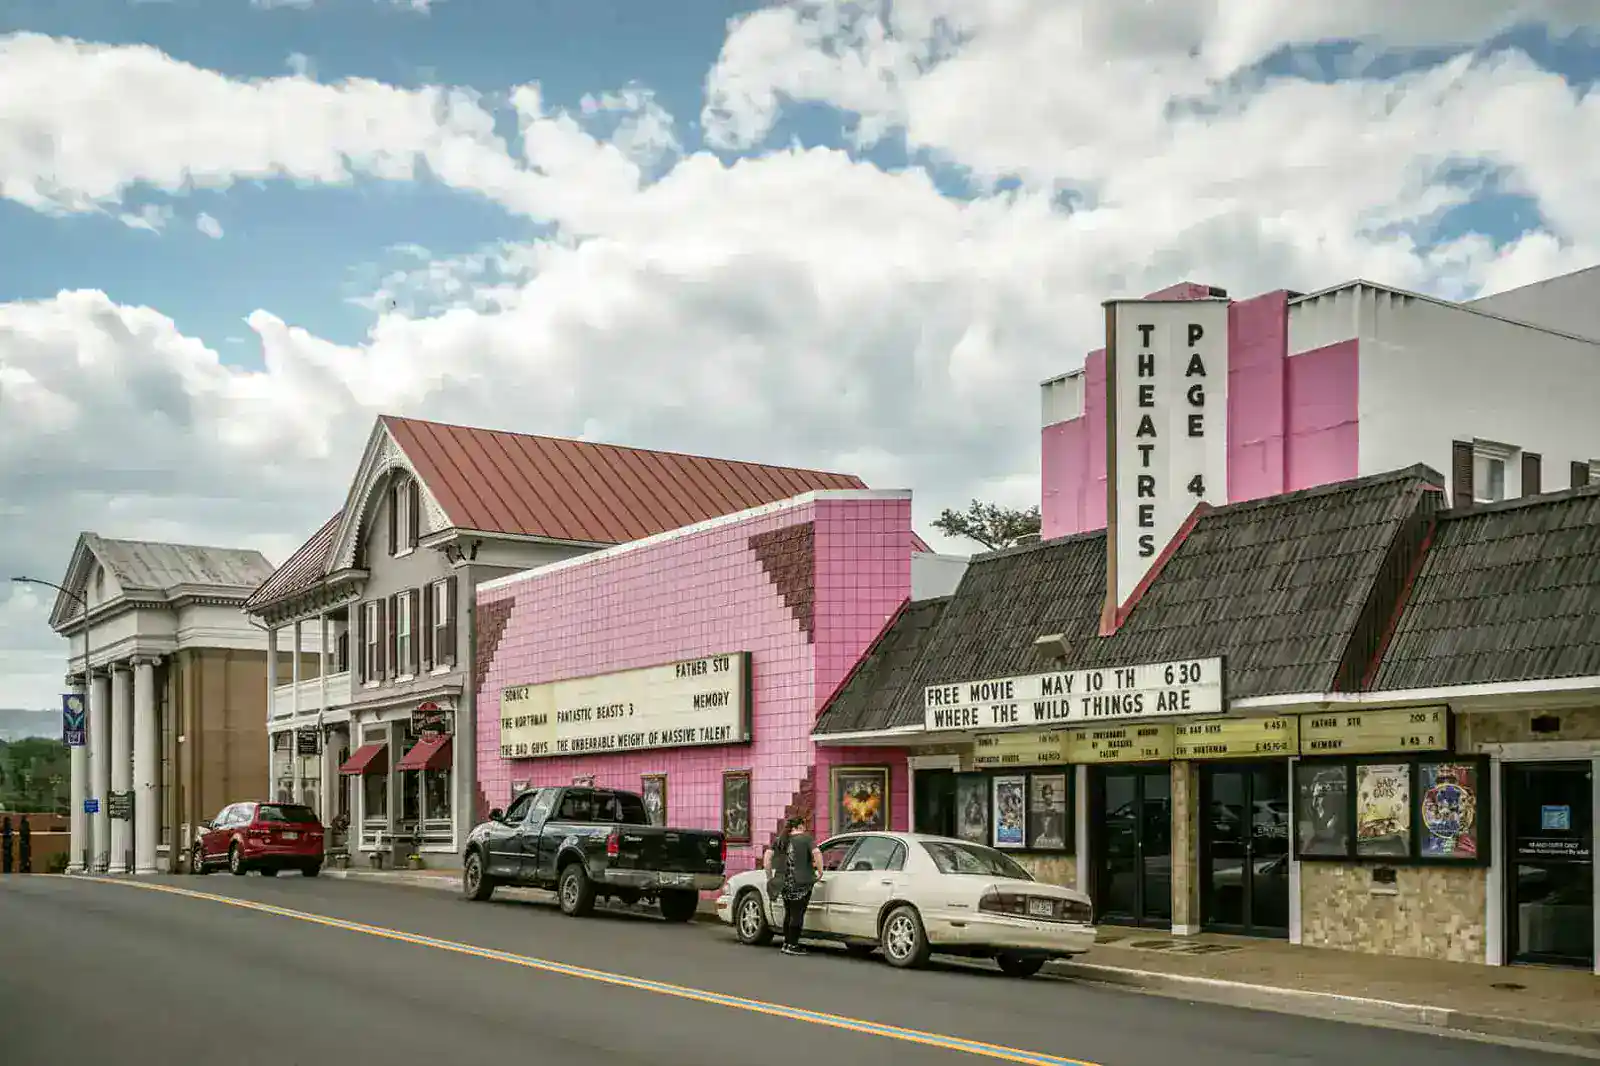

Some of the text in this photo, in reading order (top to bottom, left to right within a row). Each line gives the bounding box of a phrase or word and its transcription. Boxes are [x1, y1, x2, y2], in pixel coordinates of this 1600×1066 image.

[1186, 323, 1206, 497] PAGE 4
[1136, 323, 1157, 557] THEATRES
[676, 657, 729, 678] FATHER STU
[524, 687, 529, 700] 2
[927, 686, 960, 706] FREE
[970, 681, 1014, 702] MOVIE
[1041, 674, 1074, 695] MAY
[1086, 672, 1103, 692] 10
[1115, 668, 1135, 689] TH
[693, 691, 730, 711] MEMORY
[934, 689, 1191, 727] WHERE THE WILD THINGS ARE
[557, 703, 634, 723] FANTASTIC BEASTS 3
[502, 718, 513, 729] THE
[557, 725, 731, 751] THE UNBEARABLE WEIGHT OF MASSIVE TALENT
[1311, 740, 1342, 750] MEMORY
[502, 744, 513, 756] THE
[531, 741, 548, 753] GUYS
